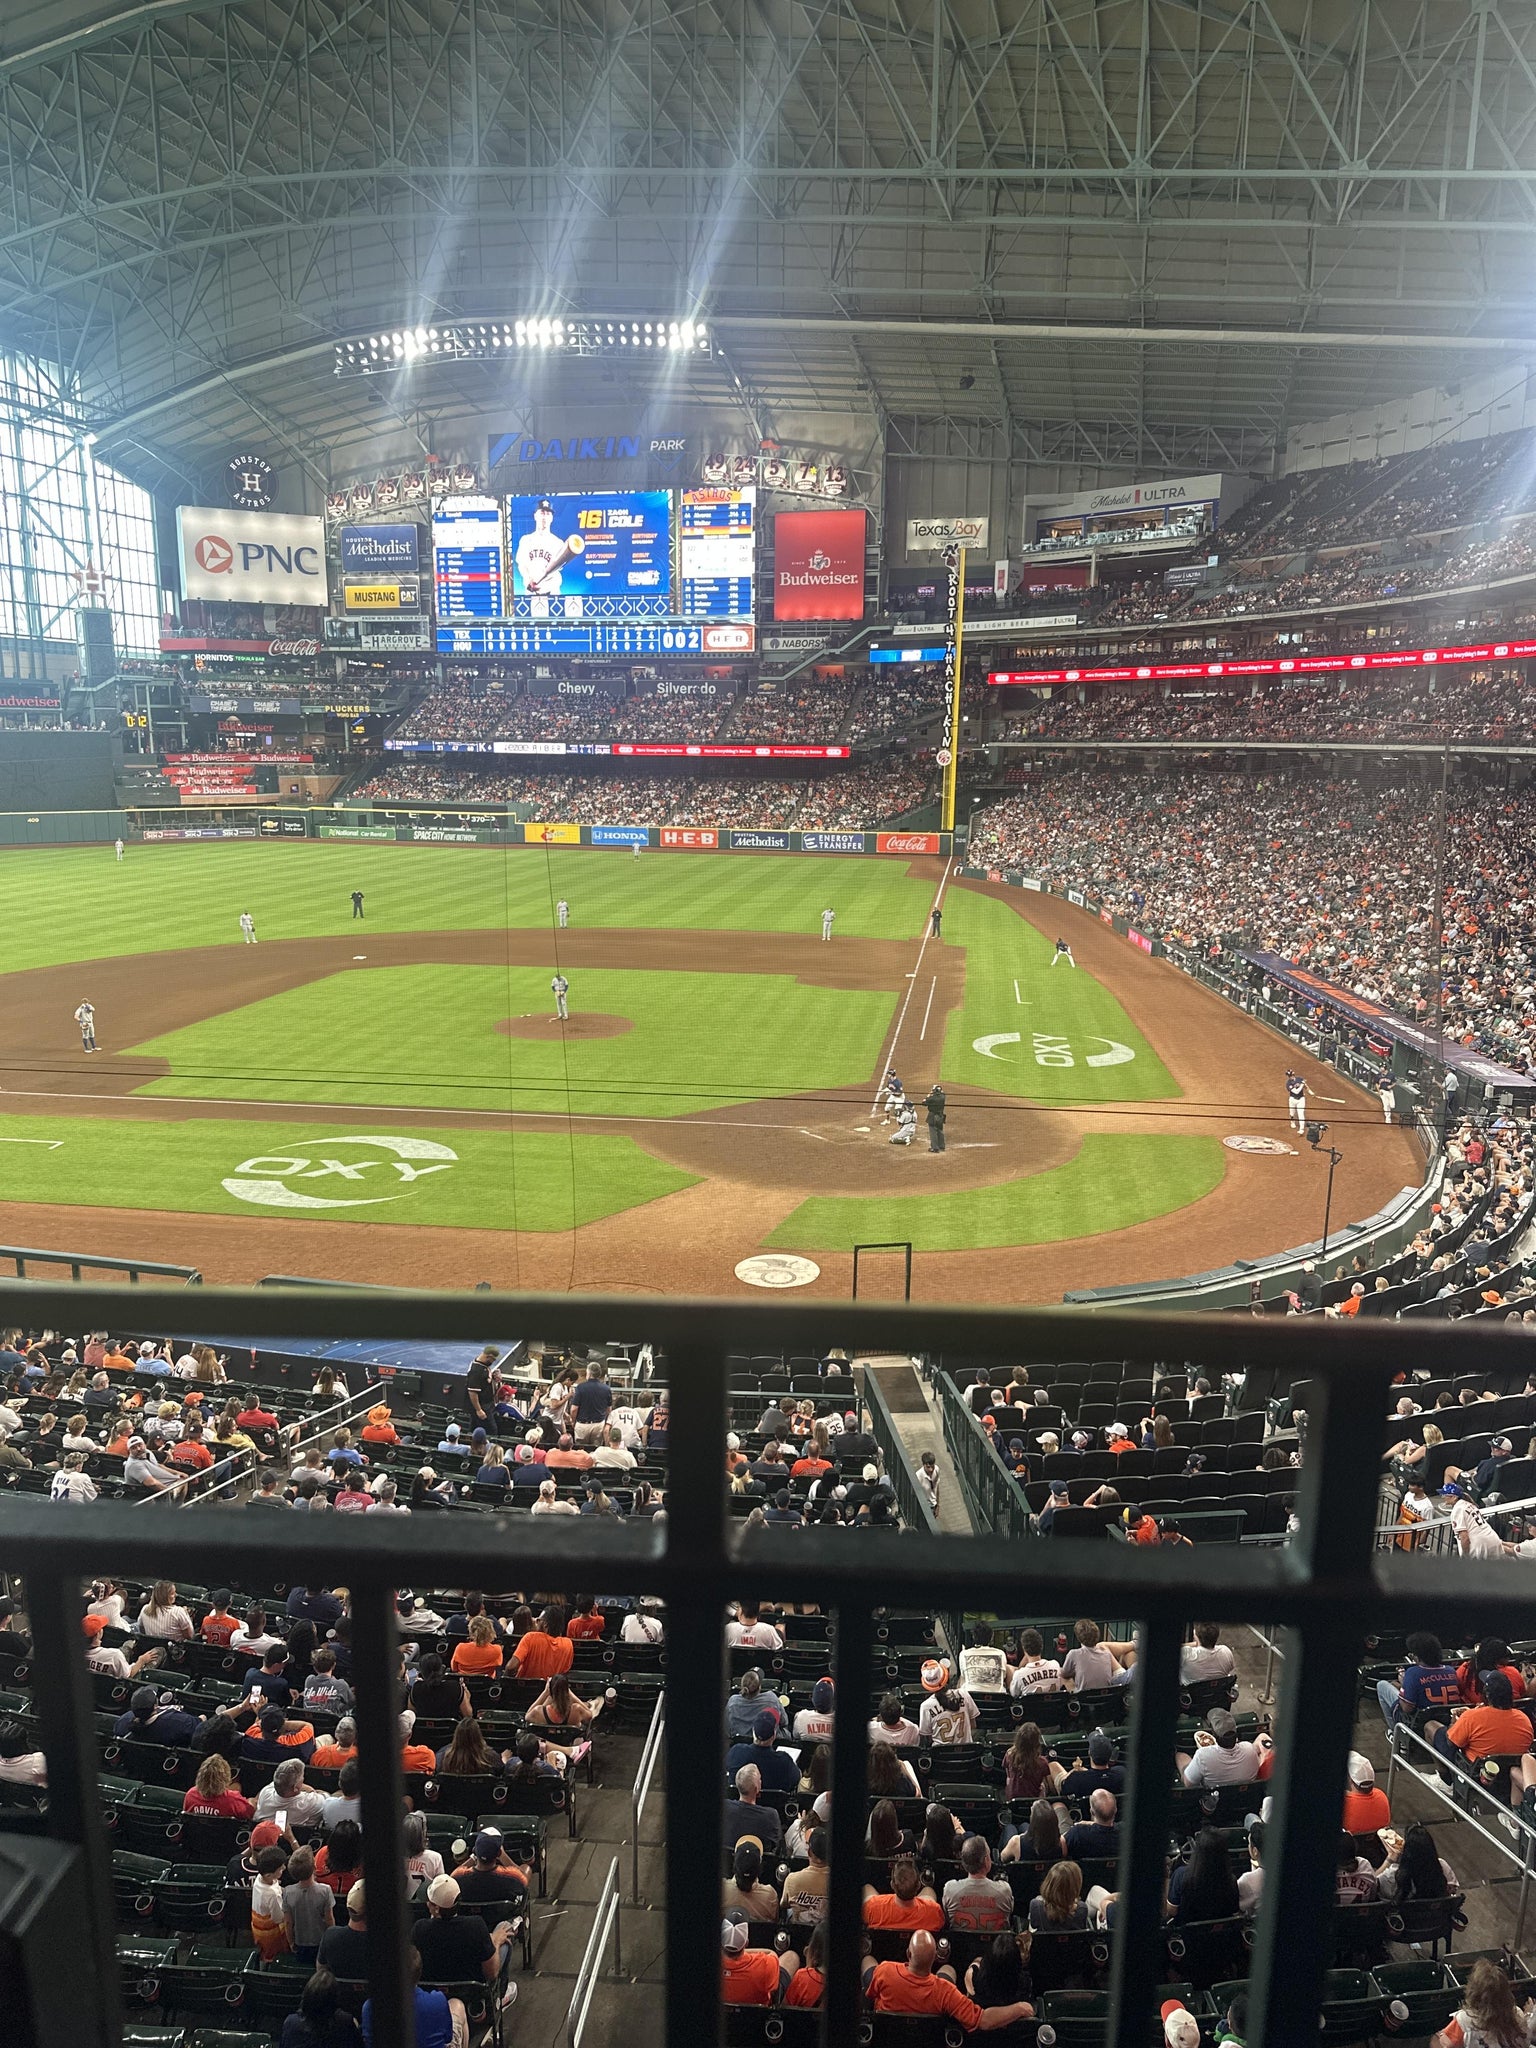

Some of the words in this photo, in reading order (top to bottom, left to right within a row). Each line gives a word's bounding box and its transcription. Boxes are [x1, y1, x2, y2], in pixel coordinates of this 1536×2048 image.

[519, 435, 640, 462] DAIKIN
[650, 439, 686, 451] PARK
[230, 456, 271, 473] HOUSTON
[705, 453, 725, 470] 49
[734, 456, 754, 472] 24
[770, 459, 779, 475] 5
[430, 468, 447, 483] 34
[456, 464, 474, 479] 42
[800, 463, 811, 479] 7
[826, 466, 844, 482] 13
[242, 472, 262, 492] H
[377, 479, 395, 494] 25
[403, 473, 420, 488] 33
[233, 493, 271, 507] ASTROS
[352, 485, 369, 500] 40
[692, 488, 733, 503] ASTROS
[1091, 494, 1132, 509] Michelob
[1145, 487, 1186, 501] ULTRA
[578, 510, 603, 529] 16
[608, 515, 644, 528] COLE
[913, 522, 950, 537] Texas
[956, 520, 983, 539] Bay
[346, 540, 412, 555] Methodist
[237, 541, 319, 575] PNC
[354, 592, 395, 602] MUSTANG
[400, 591, 416, 602] CAT
[947, 573, 958, 621] ROOT
[453, 631, 471, 640] TEX
[488, 631, 494, 640] 0
[499, 631, 505, 640] 0
[511, 631, 516, 640] 0
[522, 631, 528, 640] 0
[534, 631, 540, 640] 2
[546, 631, 552, 640] 0
[596, 632, 602, 640] 2
[612, 632, 618, 640] 2
[624, 632, 630, 640] 0
[636, 632, 642, 640] 2
[649, 632, 655, 640] 4
[945, 626, 955, 637] 4
[268, 638, 320, 656] Coca-Cola
[372, 636, 421, 648] HARGROVE
[453, 642, 472, 651] HOU
[488, 642, 494, 651] 0
[500, 642, 505, 651] 0
[511, 642, 517, 651] 0
[523, 642, 528, 651] 0
[534, 642, 540, 651] 0
[596, 642, 602, 650] 0
[612, 642, 618, 650] 4
[624, 642, 630, 650] 0
[637, 642, 642, 650] 2
[649, 642, 655, 650] 4
[663, 632, 674, 649] 0
[675, 632, 686, 649] 0
[689, 632, 699, 649] 2
[782, 639, 820, 648] NABORS
[195, 654, 234, 662] HORNITOS
[944, 640, 955, 677] THA
[558, 682, 595, 696] Chevy
[0, 696, 60, 707] udweiser
[127, 716, 147, 727] 0:12
[942, 681, 954, 748] CHIKIN
[218, 721, 274, 732] Budweiser
[479, 743, 487, 752] K
[192, 754, 235, 762] Budweiser
[261, 754, 301, 762] Budweiser
[189, 768, 234, 776] Budweiser
[203, 786, 247, 794] Budweiser
[414, 831, 430, 840] SPACE
[430, 831, 445, 840] CITY
[736, 835, 785, 848] Methodist
[886, 835, 928, 851] Coca-Cola
[819, 841, 863, 850] TRANSFER
[1033, 1032, 1075, 1067] OXY
[234, 1156, 454, 1181] OXY
[618, 1414, 634, 1425] 44
[652, 1414, 670, 1431] 27
[51, 1487, 71, 1501] 34
[211, 1632, 221, 1644] 2
[741, 1636, 756, 1646] IMAI
[90, 1660, 109, 1672] GER
[1021, 1669, 1058, 1687] ALVAREZ
[303, 1688, 315, 1699] Life
[317, 1687, 338, 1697] Wide
[1425, 1685, 1459, 1705] 43
[937, 1712, 965, 1742] 27
[407, 1857, 425, 1872] TUVE
[411, 1874, 426, 1899] 7
